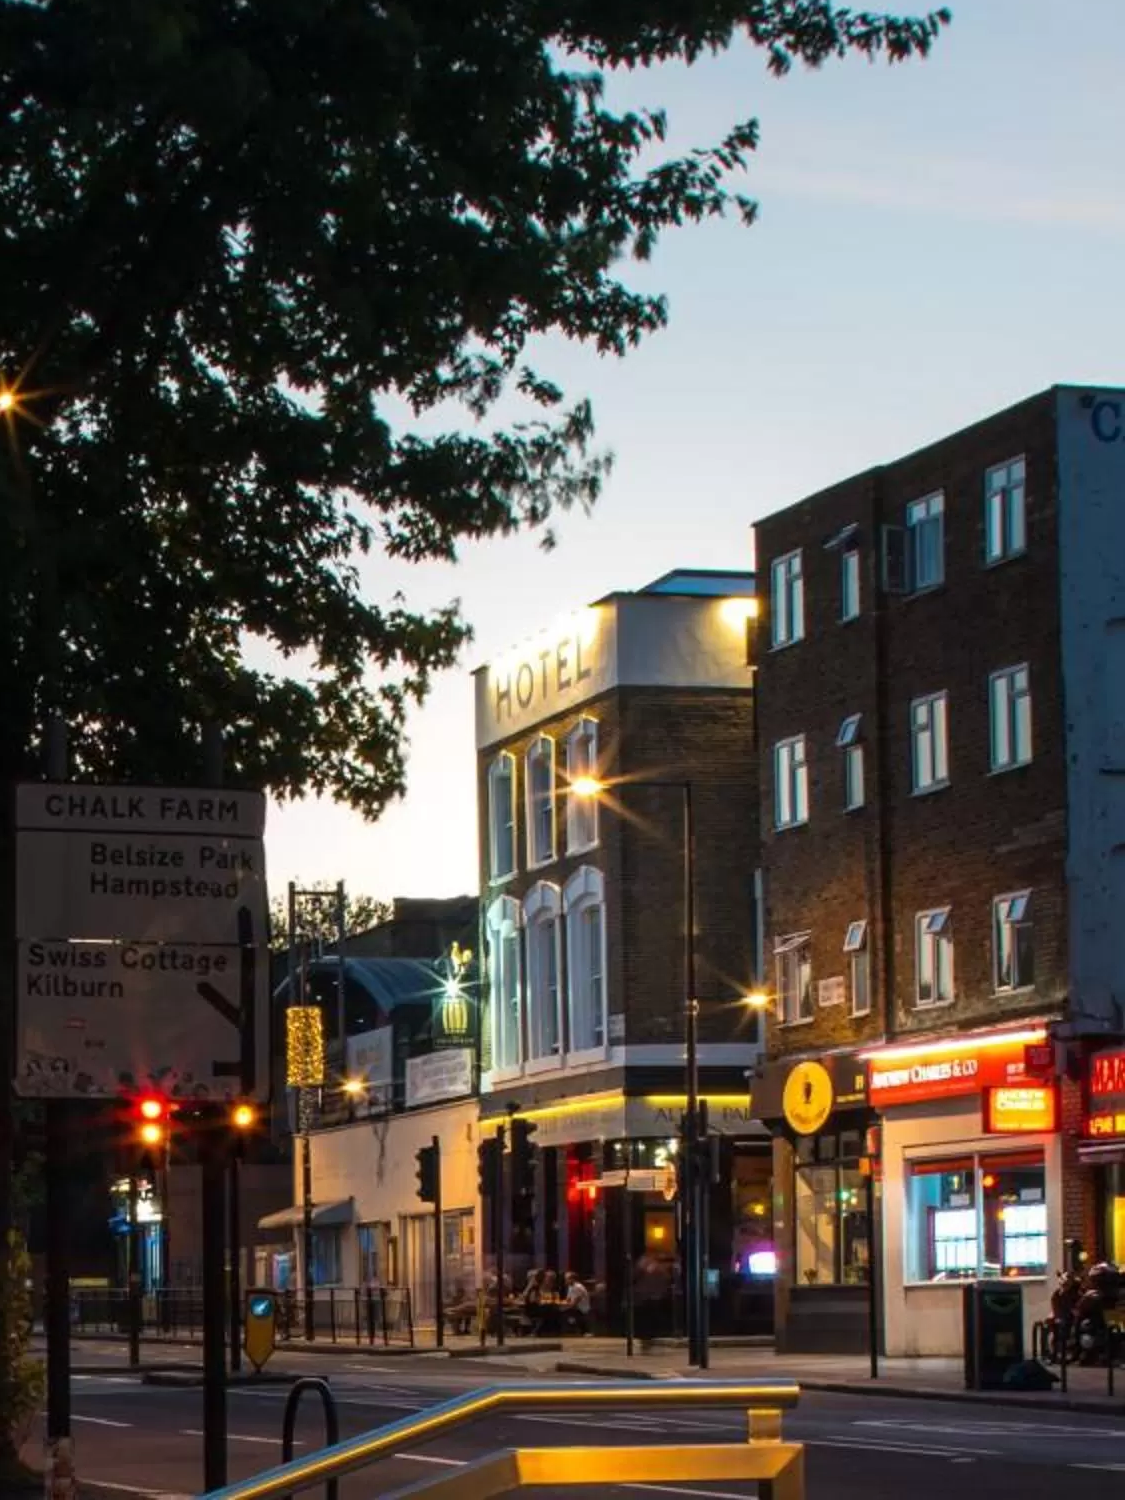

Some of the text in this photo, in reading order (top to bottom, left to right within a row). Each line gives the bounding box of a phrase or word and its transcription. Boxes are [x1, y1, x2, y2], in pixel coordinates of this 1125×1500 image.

[495, 633, 592, 724] HOTEL
[44, 794, 240, 821] CHALK FARM
[90, 843, 253, 871] Belsize Park
[90, 872, 239, 900] Hampstead
[28, 943, 228, 976] Swiss Cottage
[26, 973, 124, 998] Kilburn
